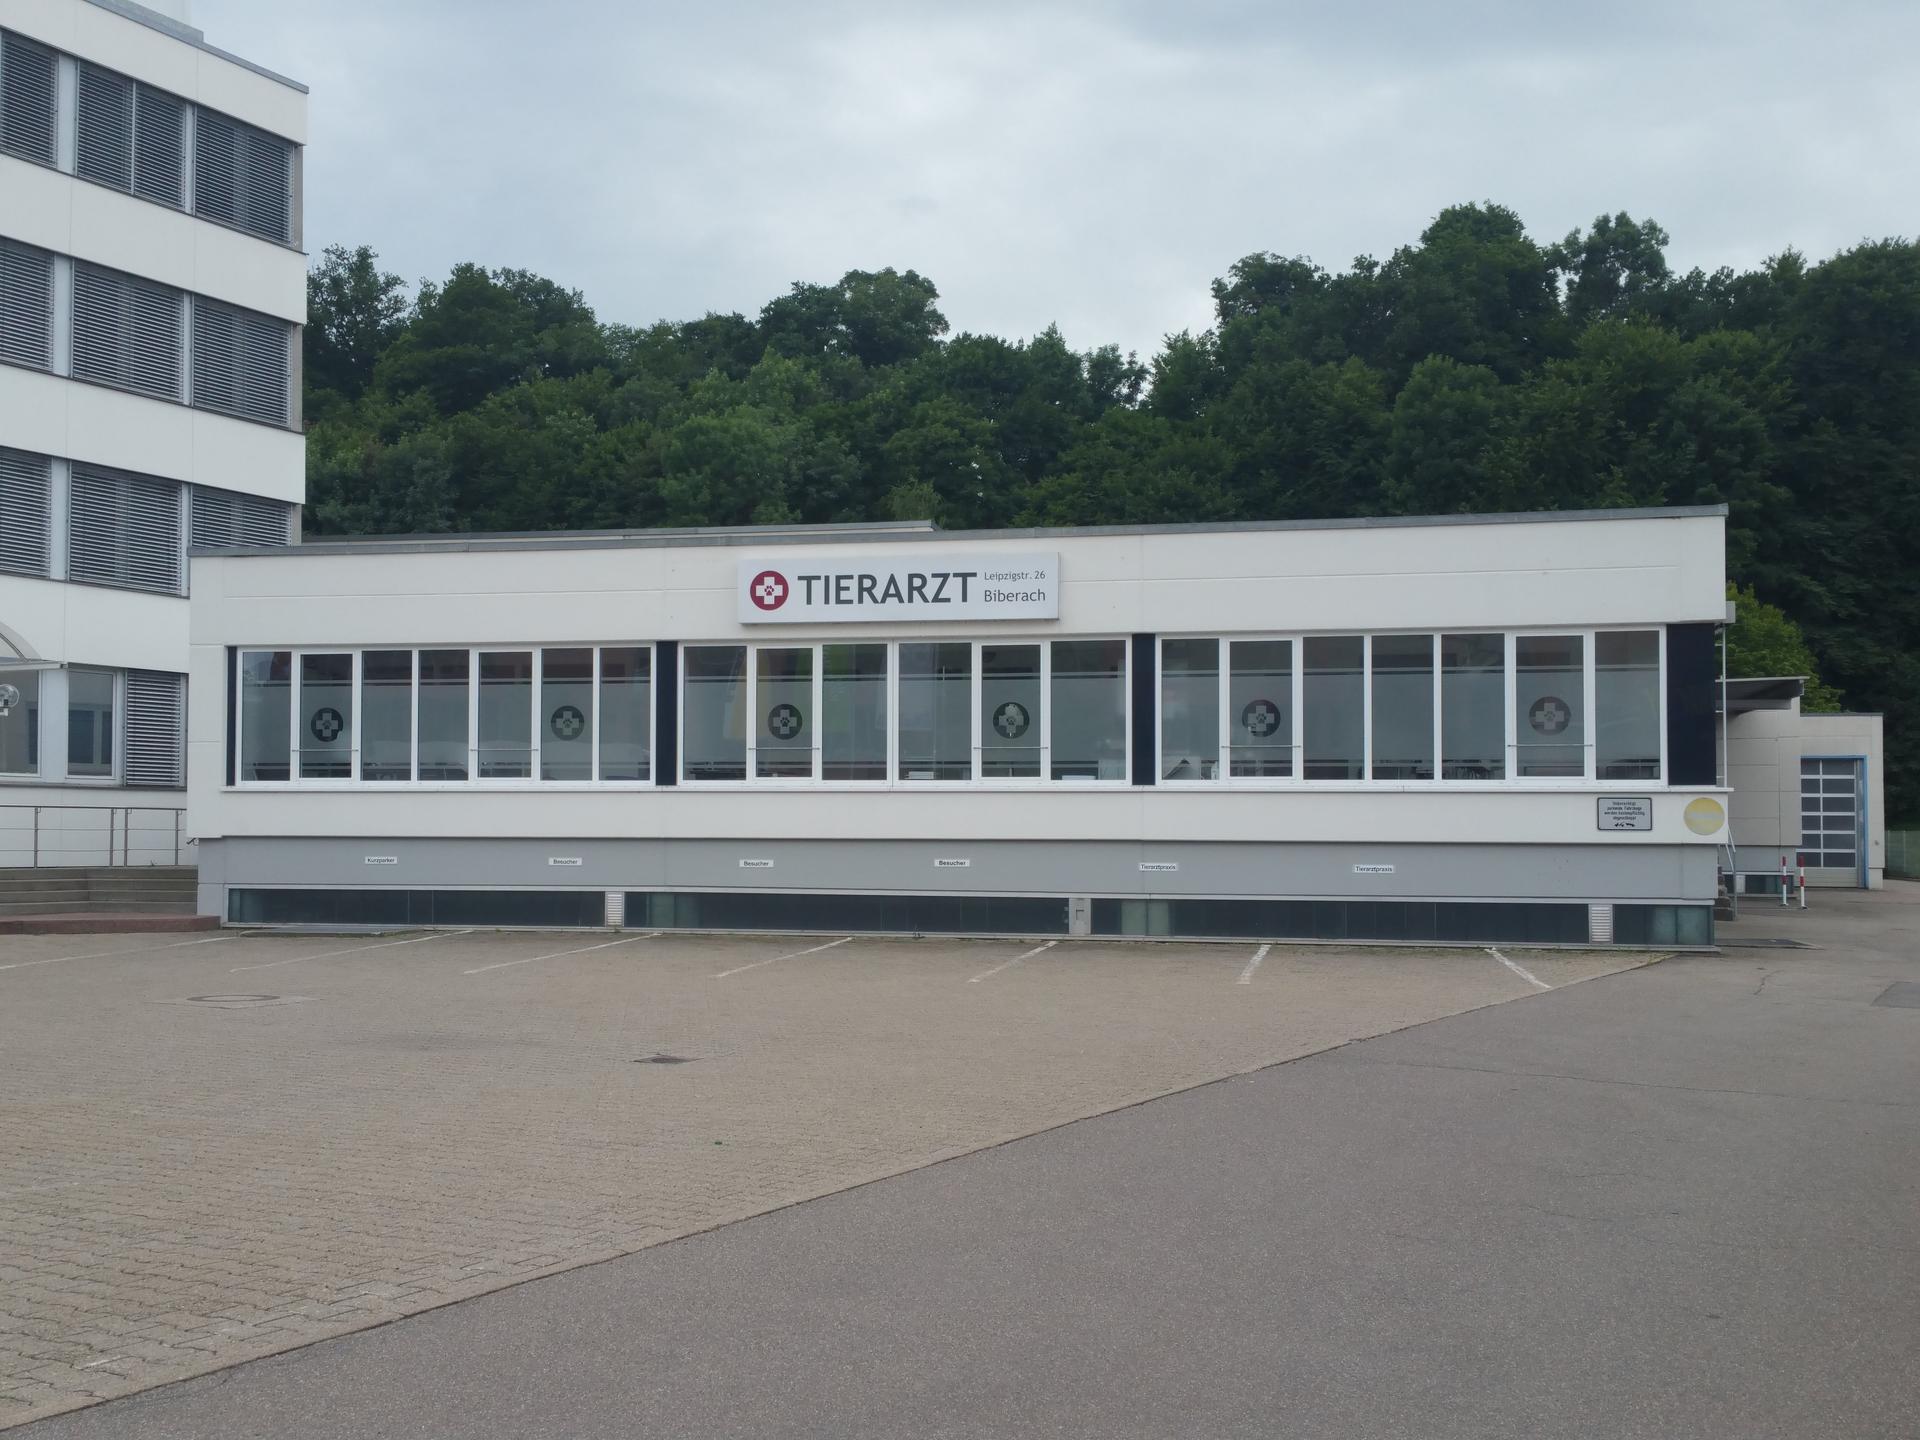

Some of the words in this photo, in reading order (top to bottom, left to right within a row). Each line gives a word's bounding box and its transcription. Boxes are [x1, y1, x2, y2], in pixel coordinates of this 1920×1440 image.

[984, 572, 1032, 582] Leipzigstr.
[1034, 570, 1046, 580] 26
[798, 572, 977, 605] TIERARZT
[984, 588, 1046, 602] Biberach
[367, 856, 395, 864] Kurzparker
[1140, 863, 1176, 871] Tierarztpraxis
[1356, 865, 1393, 873] Tierarztpraxis
